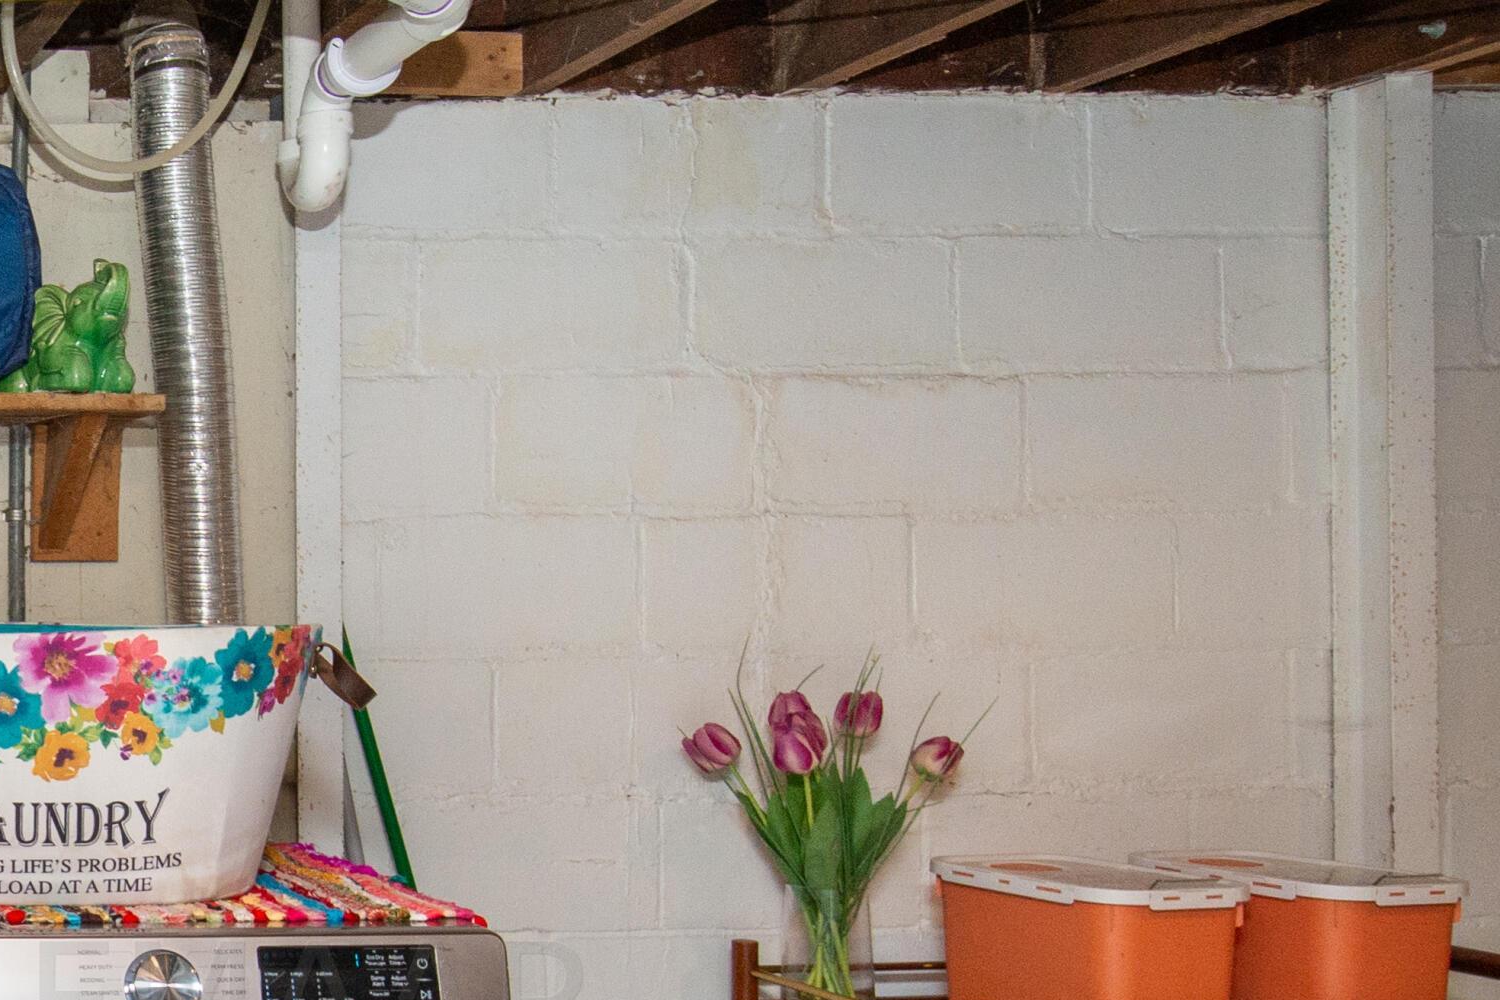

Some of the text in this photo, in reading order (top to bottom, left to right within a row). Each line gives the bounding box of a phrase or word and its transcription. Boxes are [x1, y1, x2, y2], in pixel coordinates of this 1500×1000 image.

[11, 854, 72, 874] LIFE'S
[78, 852, 182, 873] PROBLEMS
[58, 880, 82, 894] AT
[85, 879, 99, 894] A
[103, 877, 152, 892] TIME
